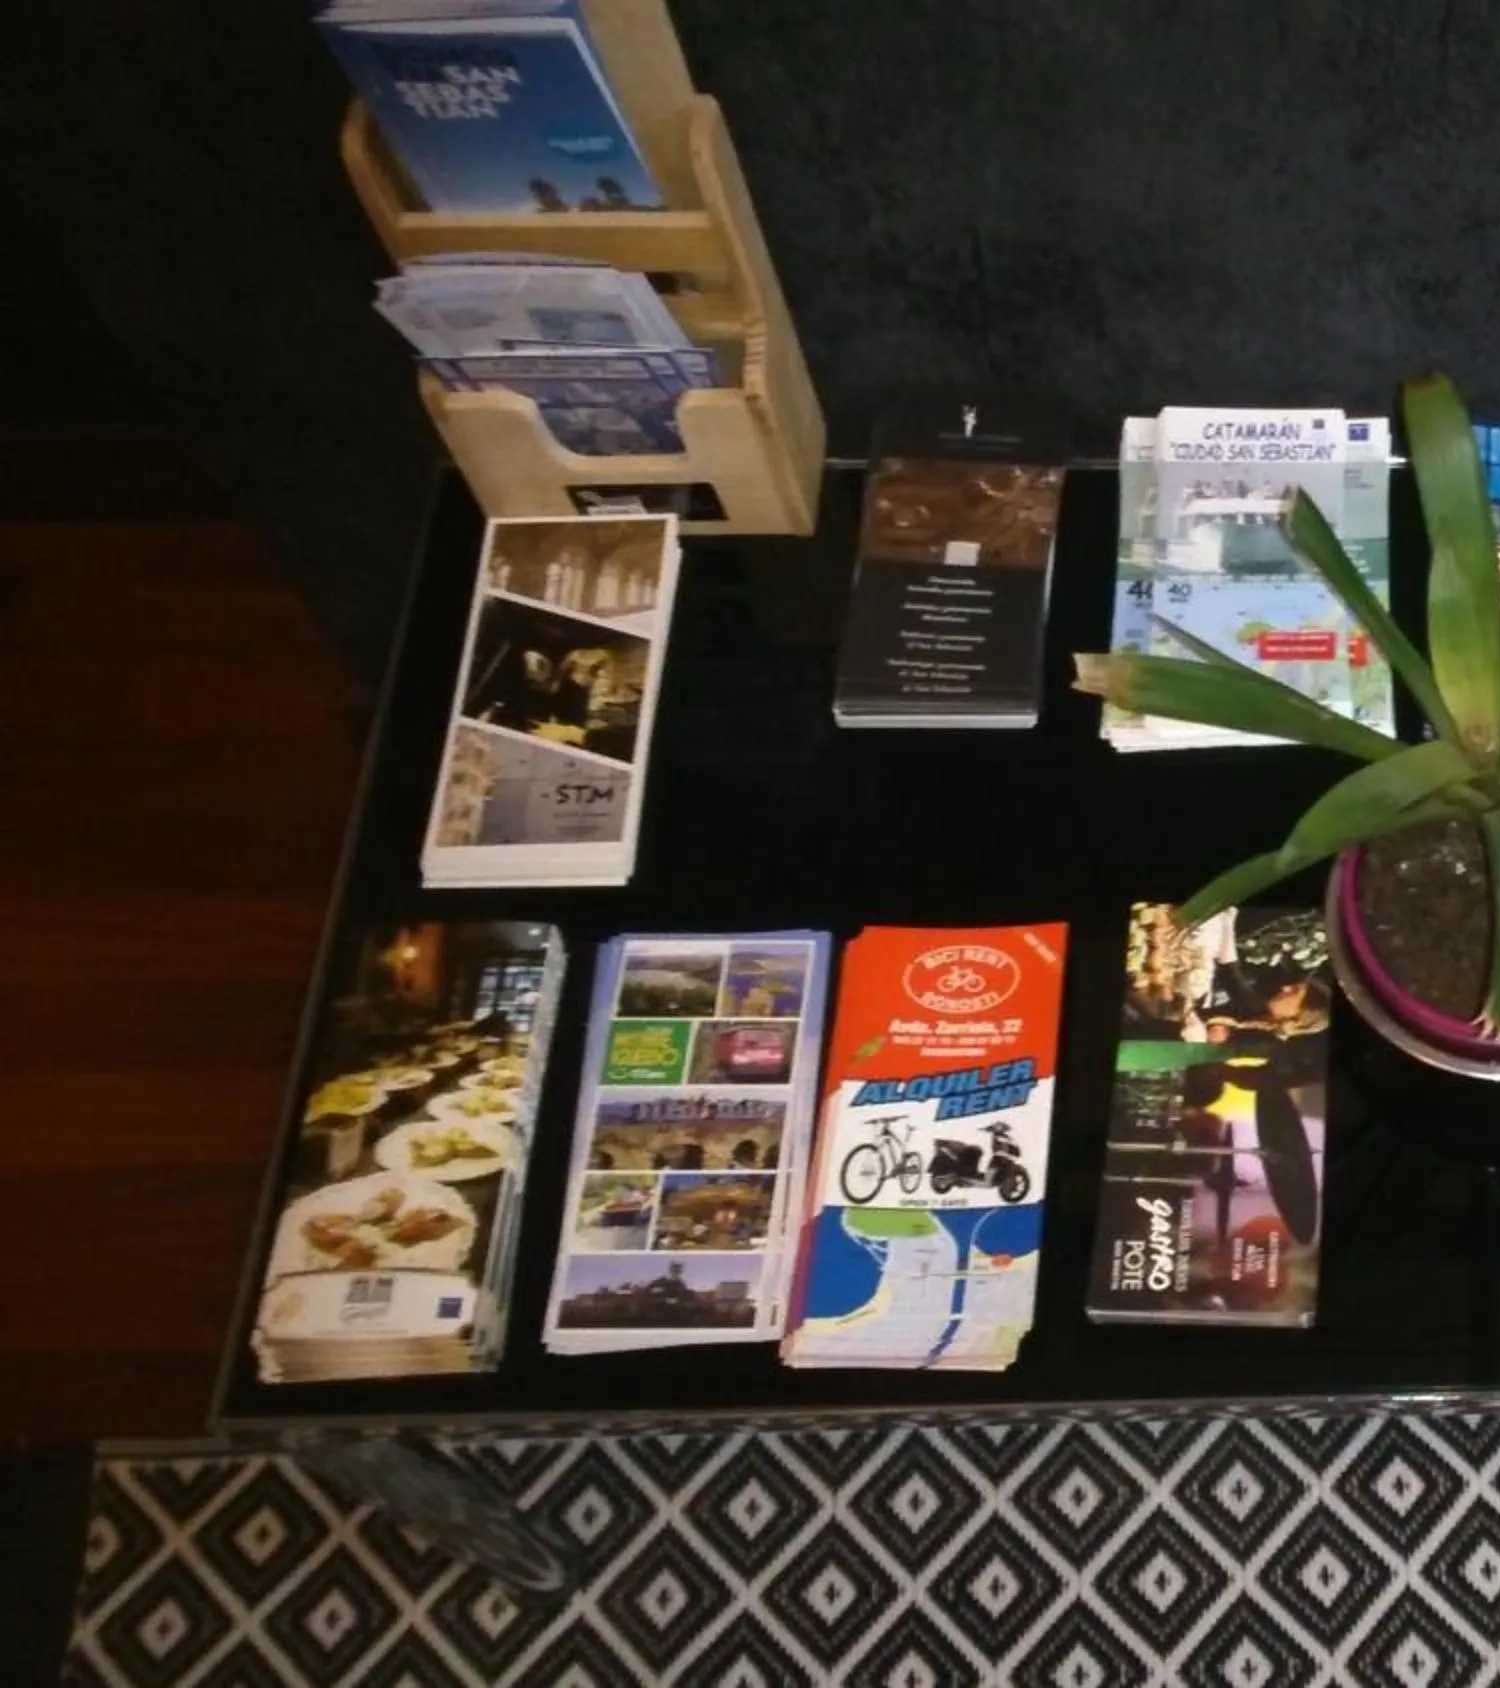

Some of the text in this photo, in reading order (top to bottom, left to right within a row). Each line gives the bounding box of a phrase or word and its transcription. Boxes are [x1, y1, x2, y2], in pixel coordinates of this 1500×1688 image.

[442, 64, 522, 85] SAN
[1203, 417, 1300, 441] CATAMARÁN
[1228, 443, 1255, 460] SAN
[556, 783, 614, 805] STM
[848, 1057, 1036, 1107] ALQUILER
[934, 1078, 1039, 1121] RENT
[1121, 1239, 1146, 1291] POTE
